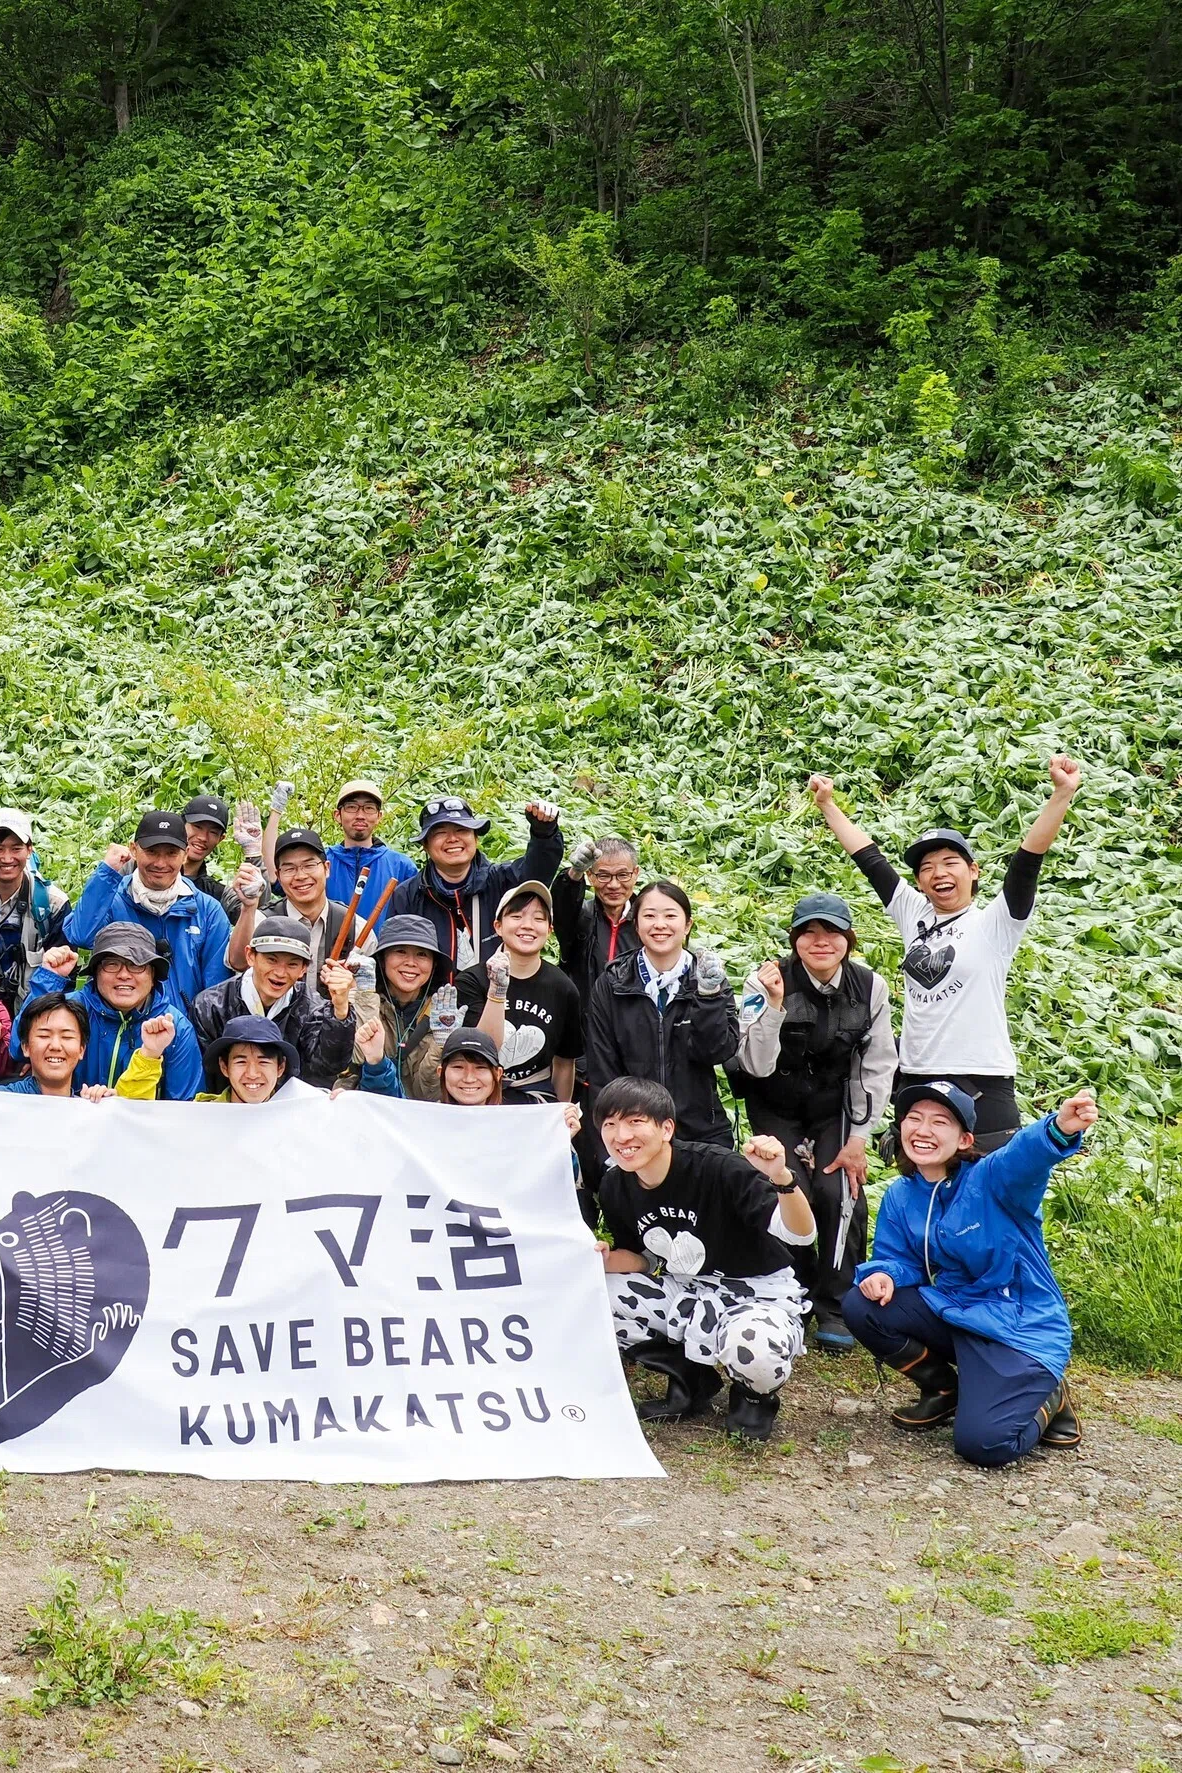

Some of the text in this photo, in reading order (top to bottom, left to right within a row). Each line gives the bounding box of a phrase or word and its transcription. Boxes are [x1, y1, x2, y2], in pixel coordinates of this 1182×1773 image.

[515, 1000, 553, 1024] BEARS
[163, 1194, 522, 1298] クマ活
[171, 1313, 533, 1377] SAVE BEARS
[179, 1387, 552, 1446] KUMAKATSU
